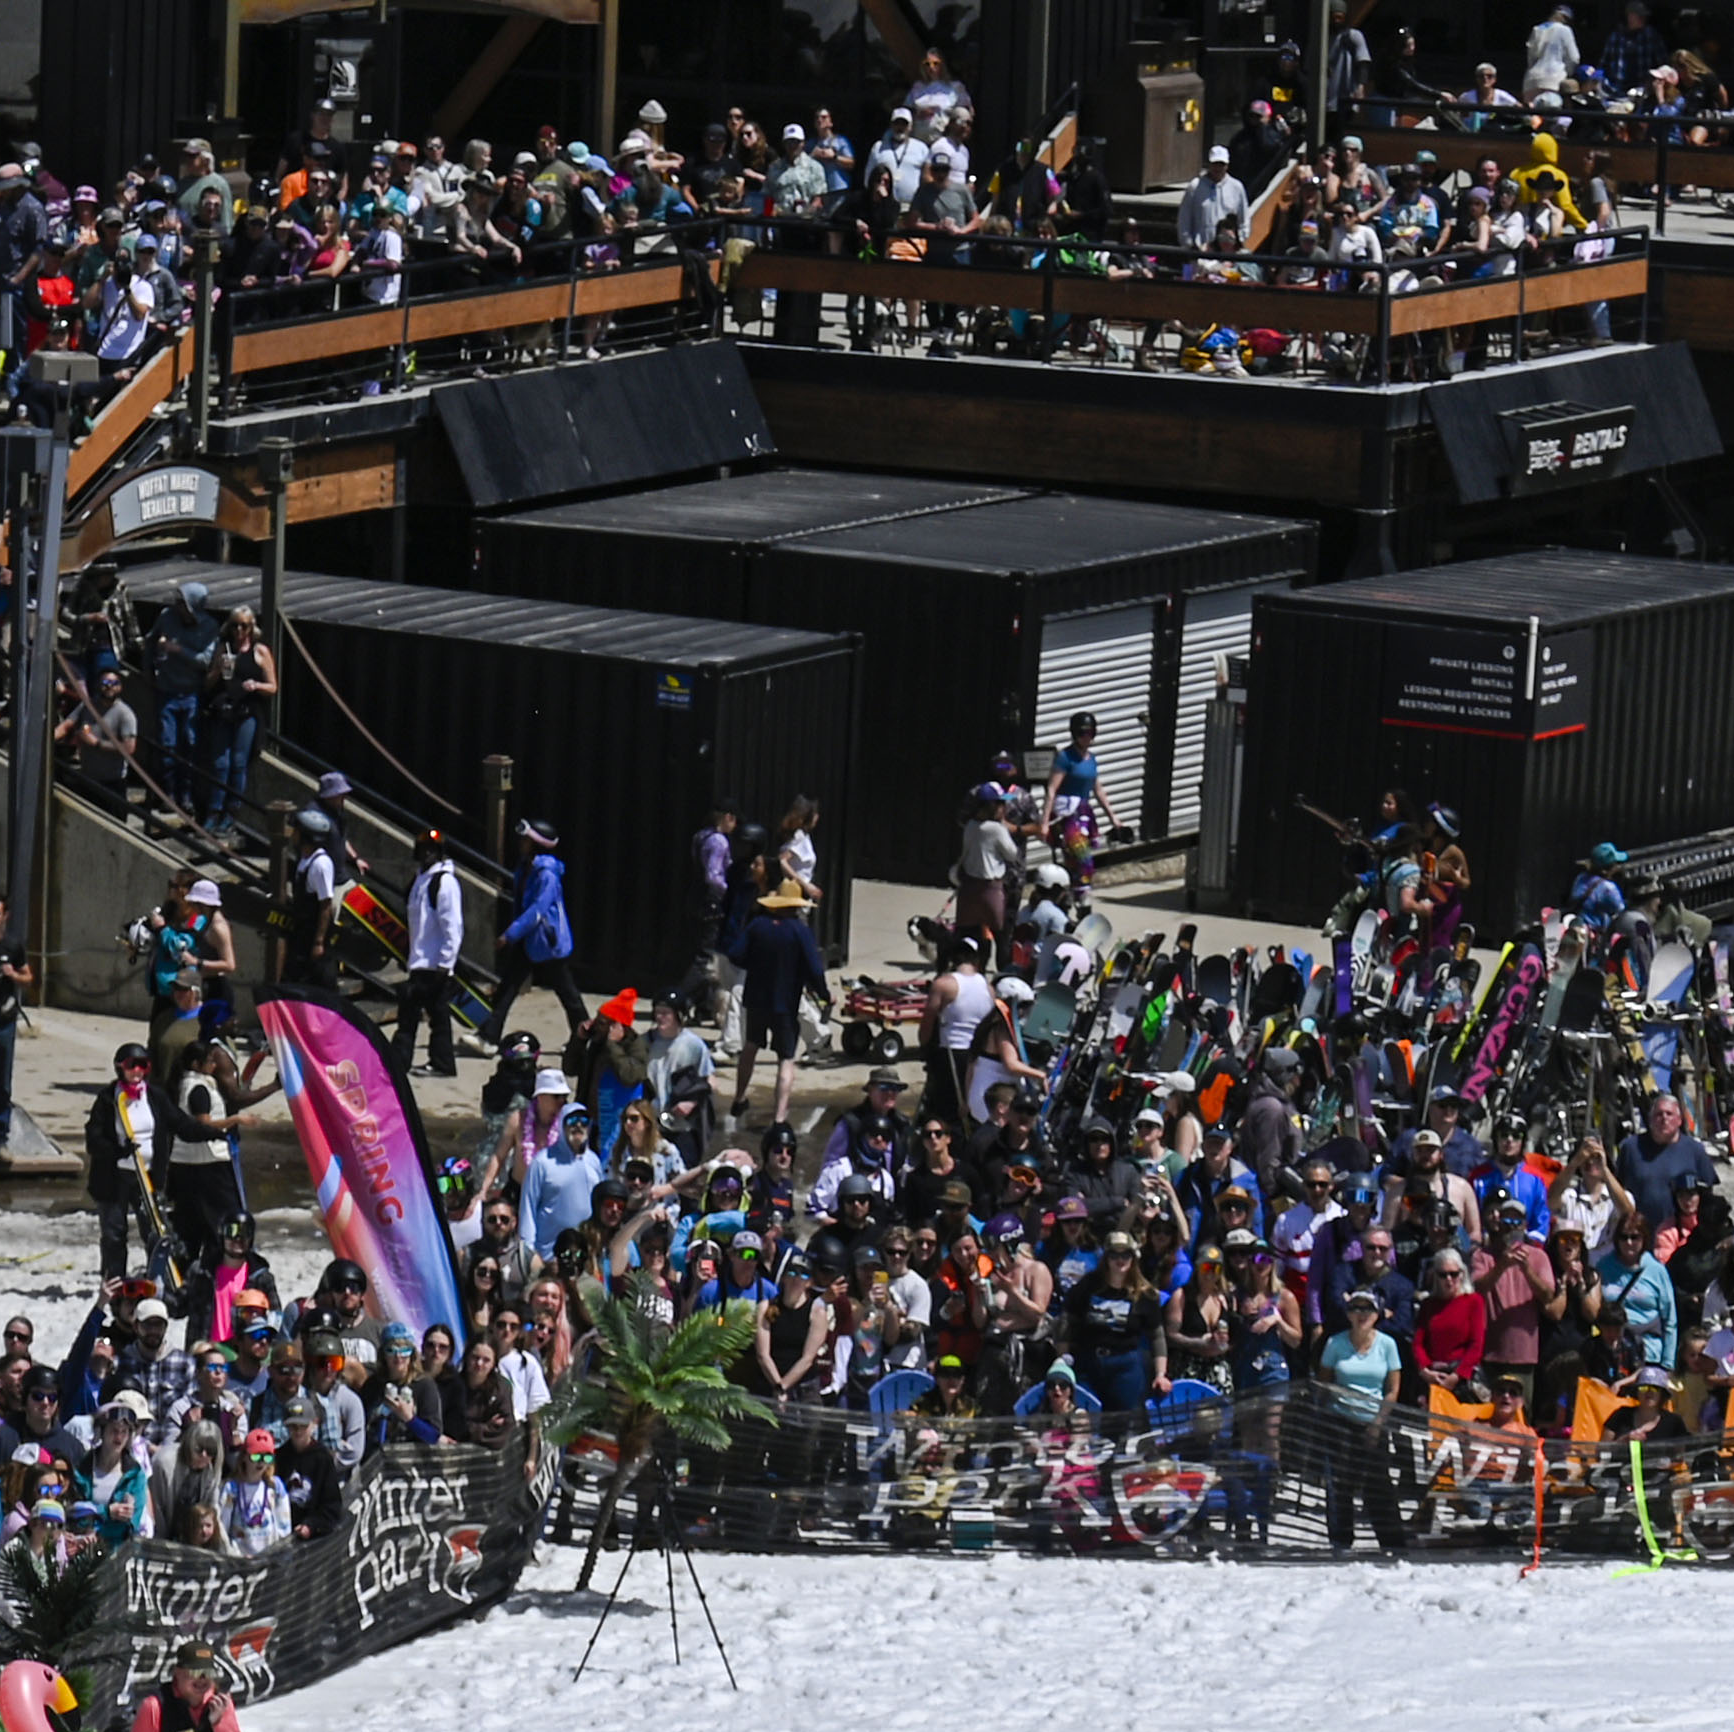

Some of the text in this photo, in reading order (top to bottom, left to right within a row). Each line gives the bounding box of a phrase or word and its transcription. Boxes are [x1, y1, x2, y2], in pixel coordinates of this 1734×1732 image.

[1572, 425, 1628, 456] RENTALS
[1430, 657, 1514, 674] PRIVATE LESSONS
[1404, 685, 1513, 704] LESSON REGISTRATION
[1471, 677, 1513, 690] RENTALS
[1399, 699, 1456, 714] RESTROOMS
[1468, 705, 1511, 720] LOCKERS
[326, 1059, 405, 1226] SPRING
[846, 1424, 1163, 1476] Winter
[348, 1462, 469, 1558] Winter
[124, 1556, 268, 1628] Winter
